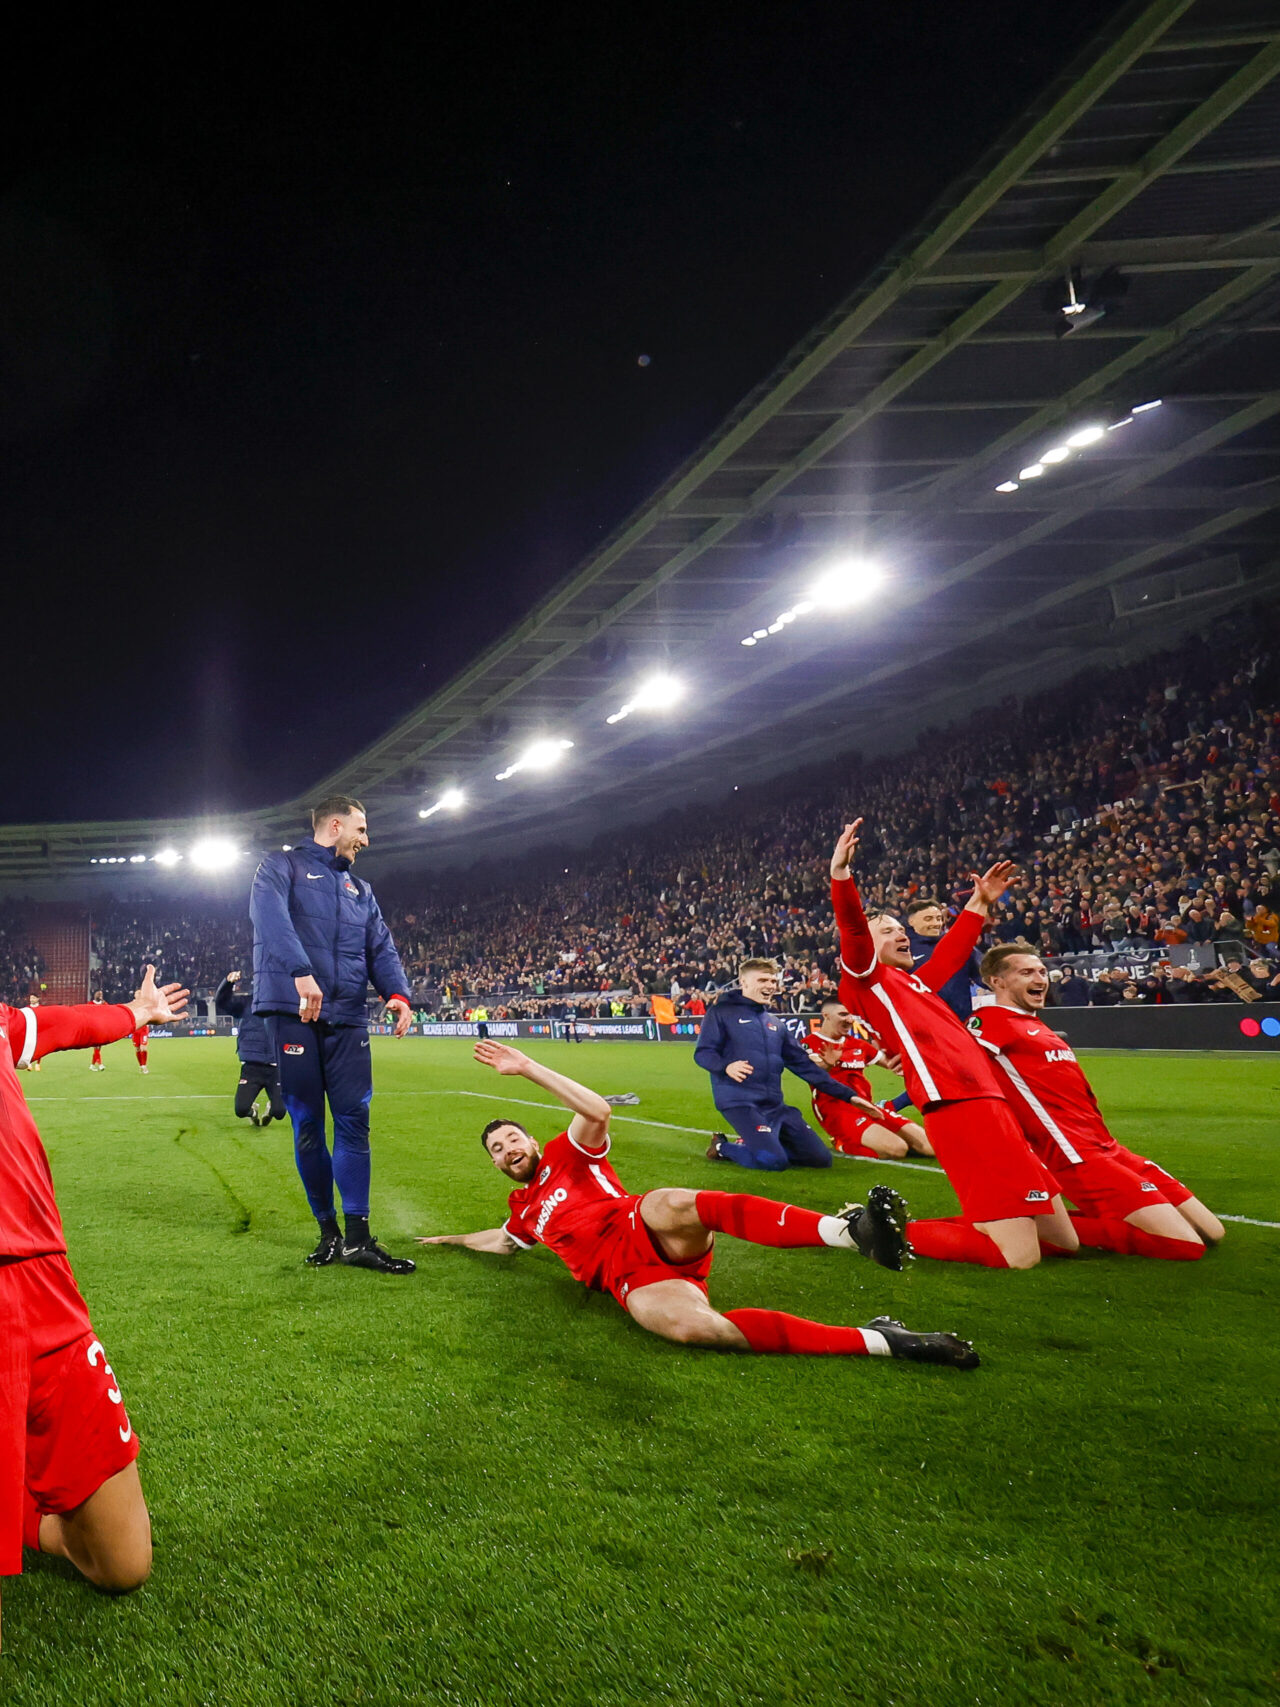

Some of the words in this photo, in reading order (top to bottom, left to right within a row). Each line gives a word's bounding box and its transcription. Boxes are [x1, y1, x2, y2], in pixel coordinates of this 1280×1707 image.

[1083, 965, 1145, 982] LEAUE
[457, 1023, 472, 1035] CHILD
[780, 1019, 807, 1039] FA
